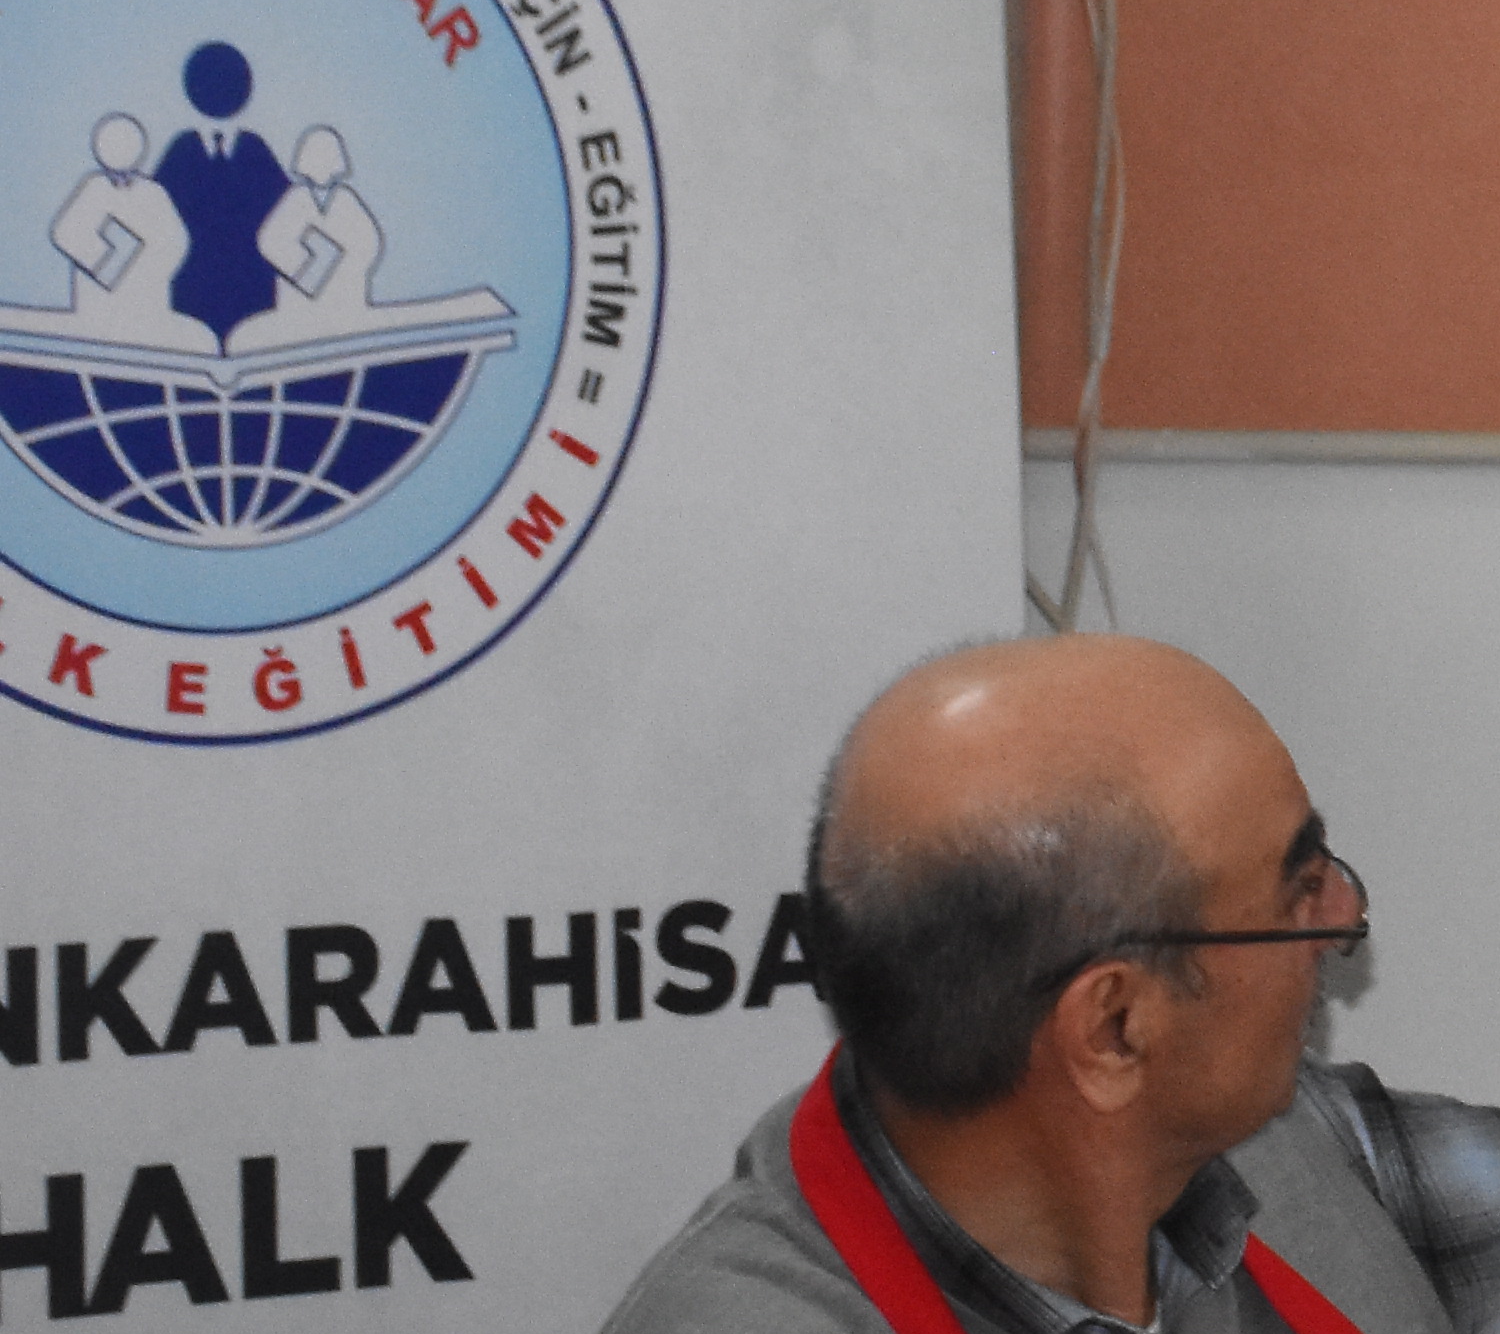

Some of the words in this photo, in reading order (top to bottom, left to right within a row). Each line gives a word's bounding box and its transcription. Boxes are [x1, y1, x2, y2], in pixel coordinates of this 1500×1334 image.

[578, 129, 640, 349] EĞİTİM
[165, 428, 600, 716] EĞİTİMİ
[0, 892, 820, 1065] KARAHİSA
